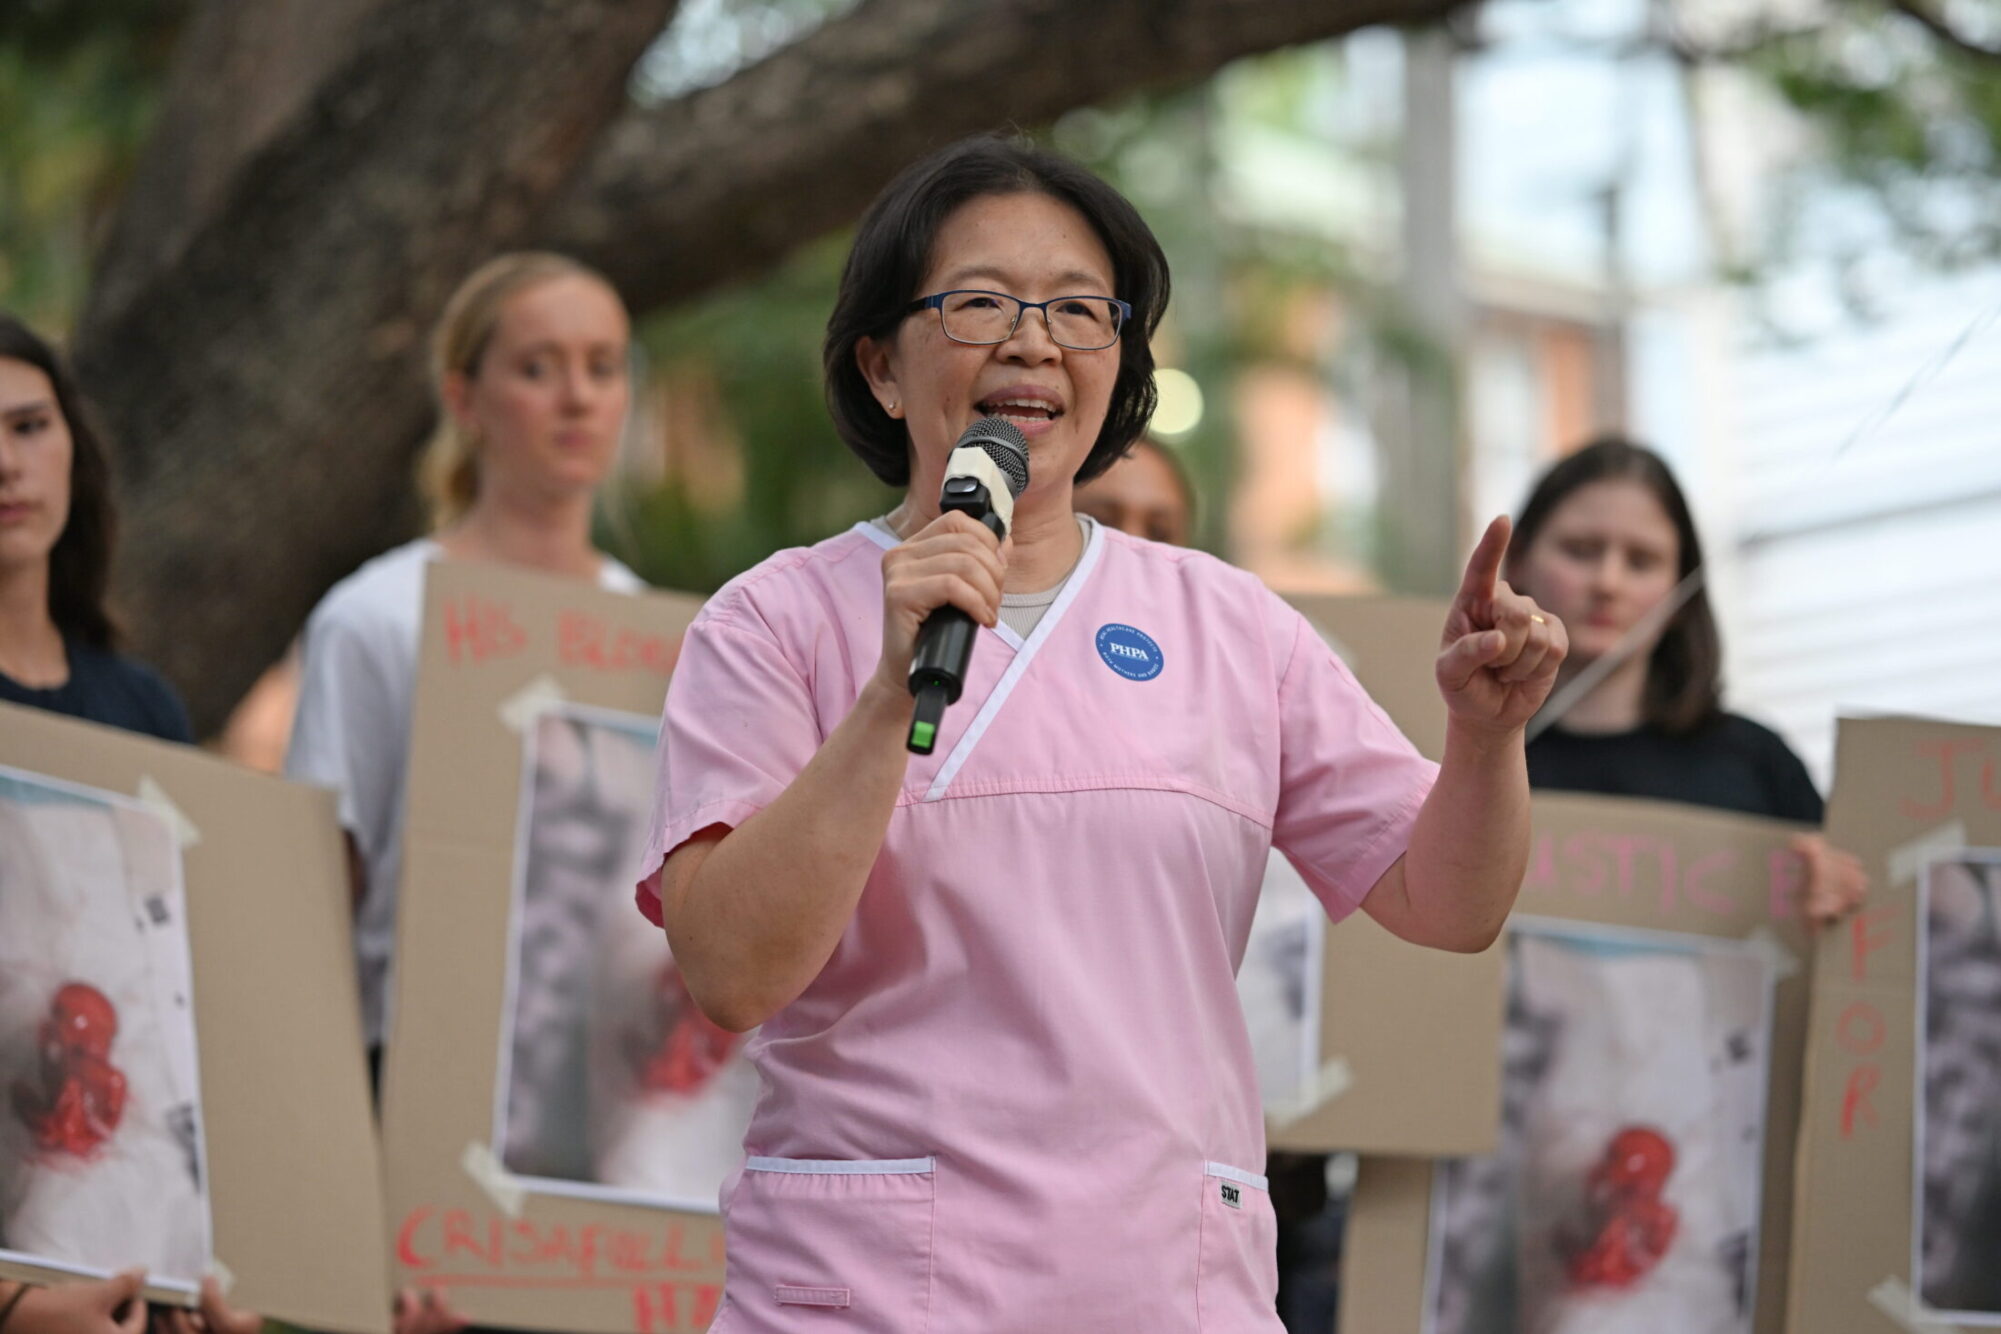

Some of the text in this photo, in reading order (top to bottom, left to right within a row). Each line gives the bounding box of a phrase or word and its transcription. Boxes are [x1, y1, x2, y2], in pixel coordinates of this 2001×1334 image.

[1110, 642, 1149, 661] PHPA
[1523, 828, 1806, 919] USTICE
[1836, 904, 1905, 1140] FOR
[1221, 1185, 1240, 1203] STAT
